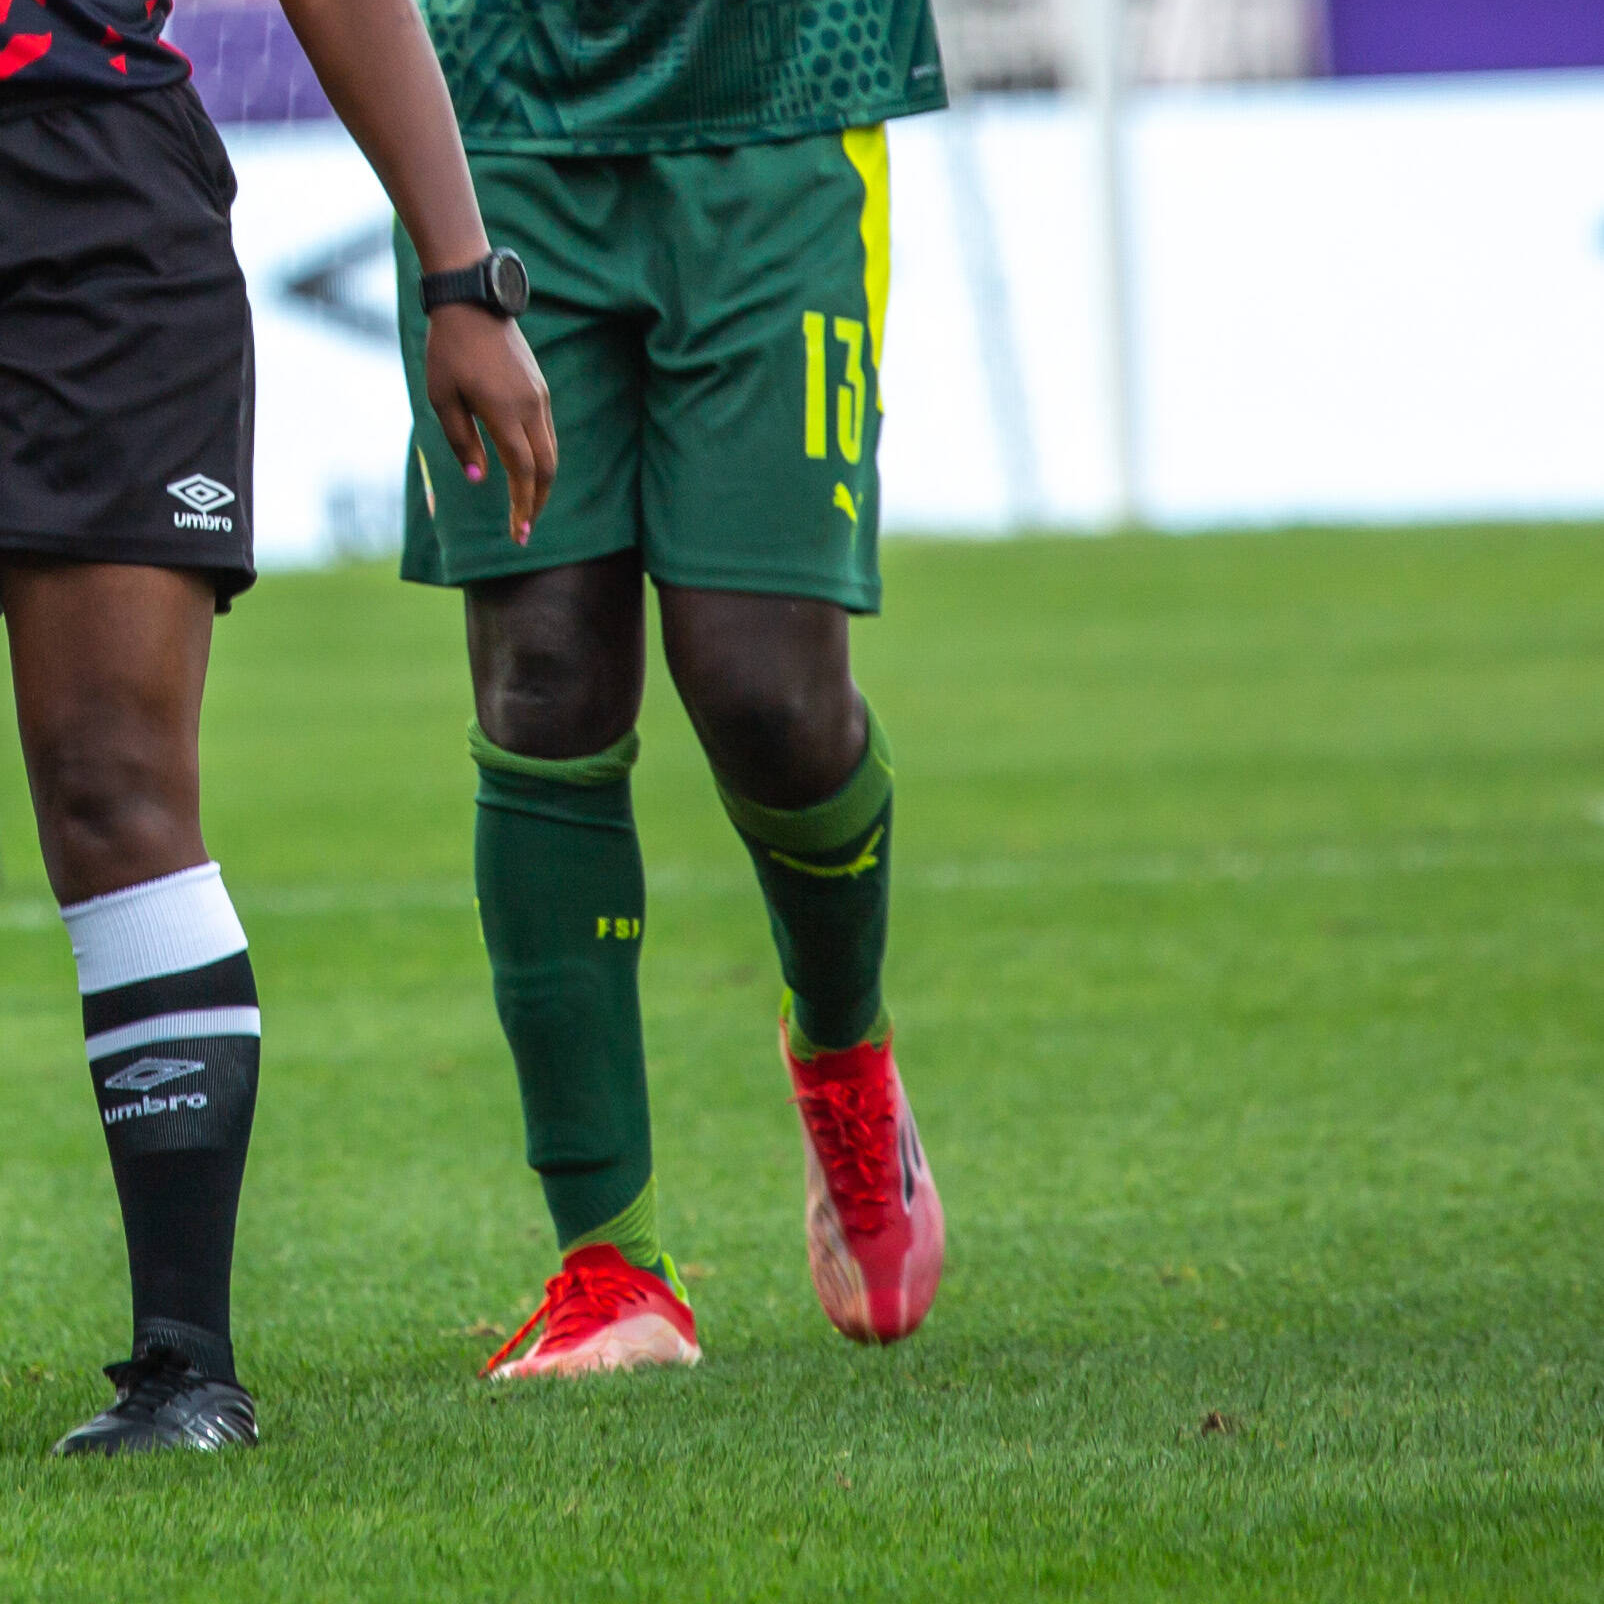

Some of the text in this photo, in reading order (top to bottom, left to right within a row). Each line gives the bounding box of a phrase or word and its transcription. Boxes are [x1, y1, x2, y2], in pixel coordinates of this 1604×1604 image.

[802, 309, 867, 466] 13
[174, 508, 233, 532] umbro
[104, 1092, 208, 1125] umbro
